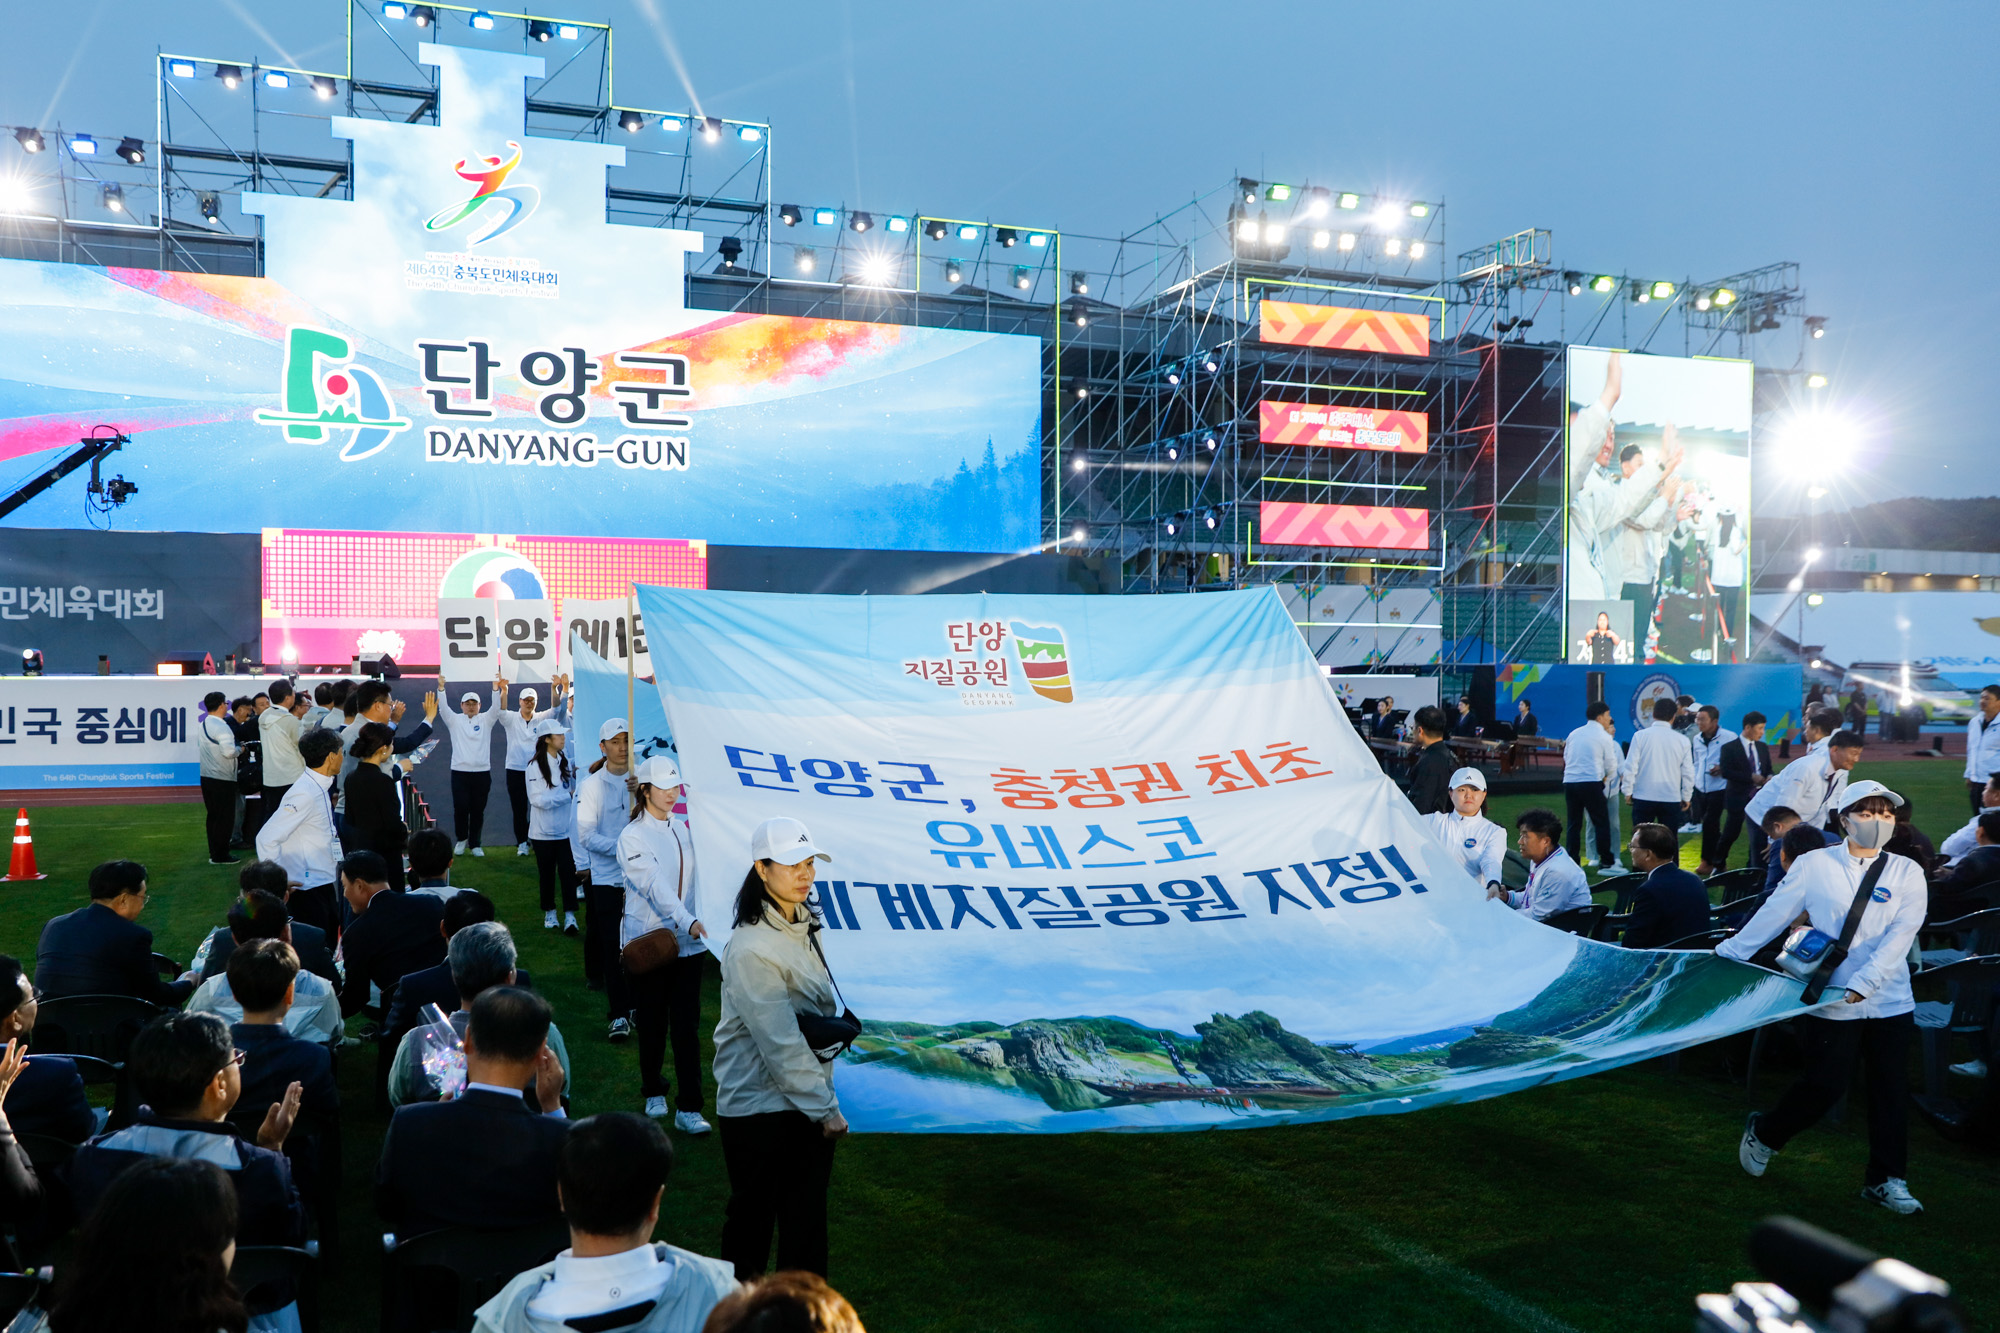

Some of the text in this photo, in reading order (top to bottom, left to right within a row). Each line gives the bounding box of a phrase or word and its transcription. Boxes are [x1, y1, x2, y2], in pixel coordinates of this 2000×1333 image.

[406, 262, 558, 286] 제64회 충북도민체육대회
[418, 341, 690, 426] 단양군
[429, 431, 686, 466] DANYANG-GUN
[0, 585, 164, 621] 민체육대회
[947, 621, 1007, 652] 단양
[905, 657, 1009, 687] 지질공원
[75, 706, 186, 744] 중심에
[42, 774, 58, 782] The
[78, 773, 118, 783] Chungbuk
[119, 772, 145, 782] Sports
[145, 771, 175, 780] Festival
[723, 741, 1334, 814] 단양군, 충청권 최초
[925, 815, 1218, 870] 유네스코
[1242, 844, 1429, 916] 지정!
